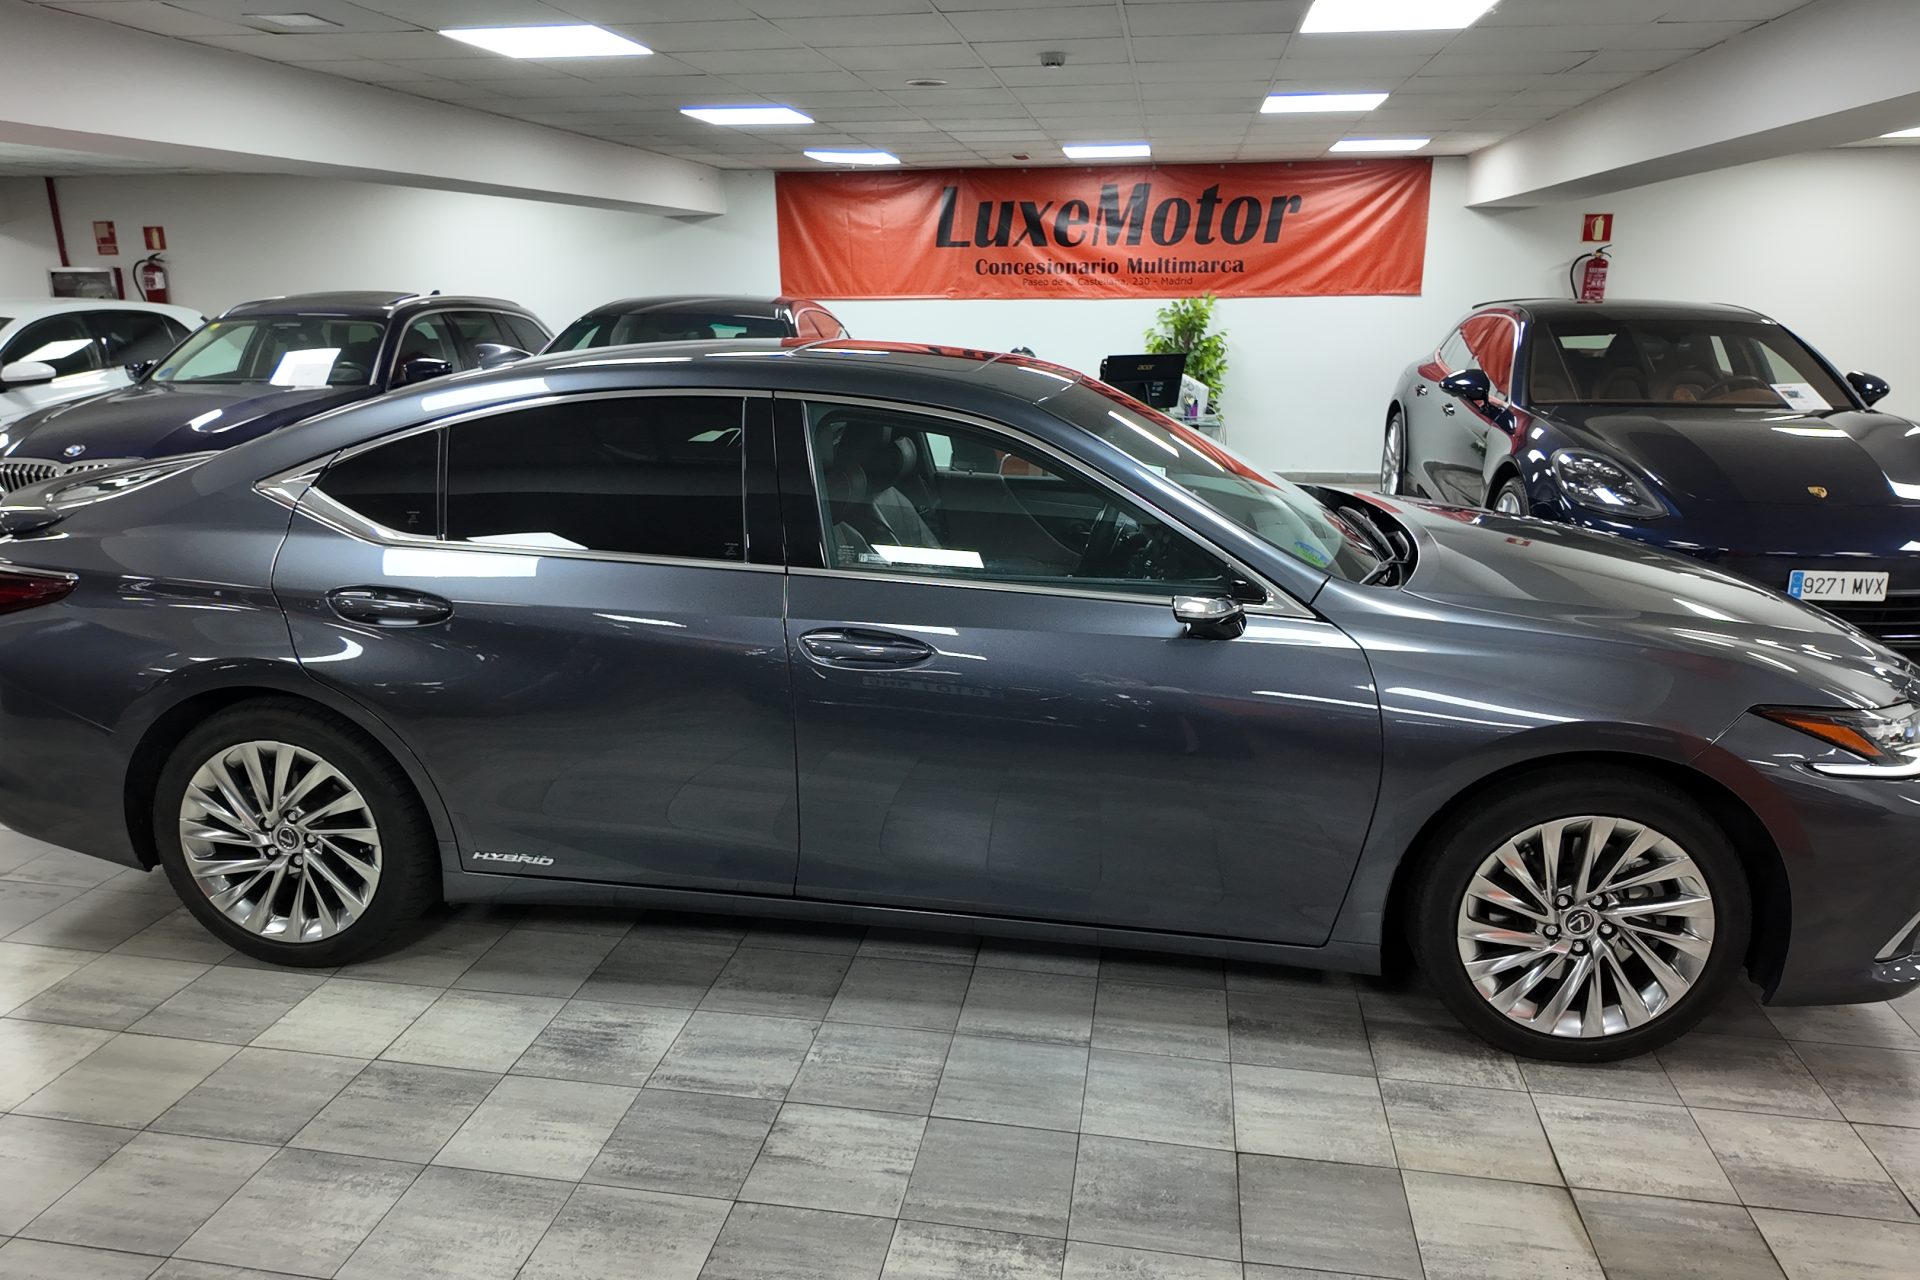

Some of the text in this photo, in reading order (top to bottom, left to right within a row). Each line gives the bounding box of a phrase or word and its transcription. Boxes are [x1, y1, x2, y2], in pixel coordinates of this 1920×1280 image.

[935, 182, 1303, 248] LuxeMotor
[975, 256, 1245, 276] Concesionario Multimarca
[1022, 277, 1049, 287] Paseo
[1051, 277, 1064, 287] de
[1132, 276, 1150, 286] 230
[1160, 276, 1193, 286] Madrid
[1803, 577, 1885, 595] 9271 MVX
[472, 851, 554, 866] HYBRID
